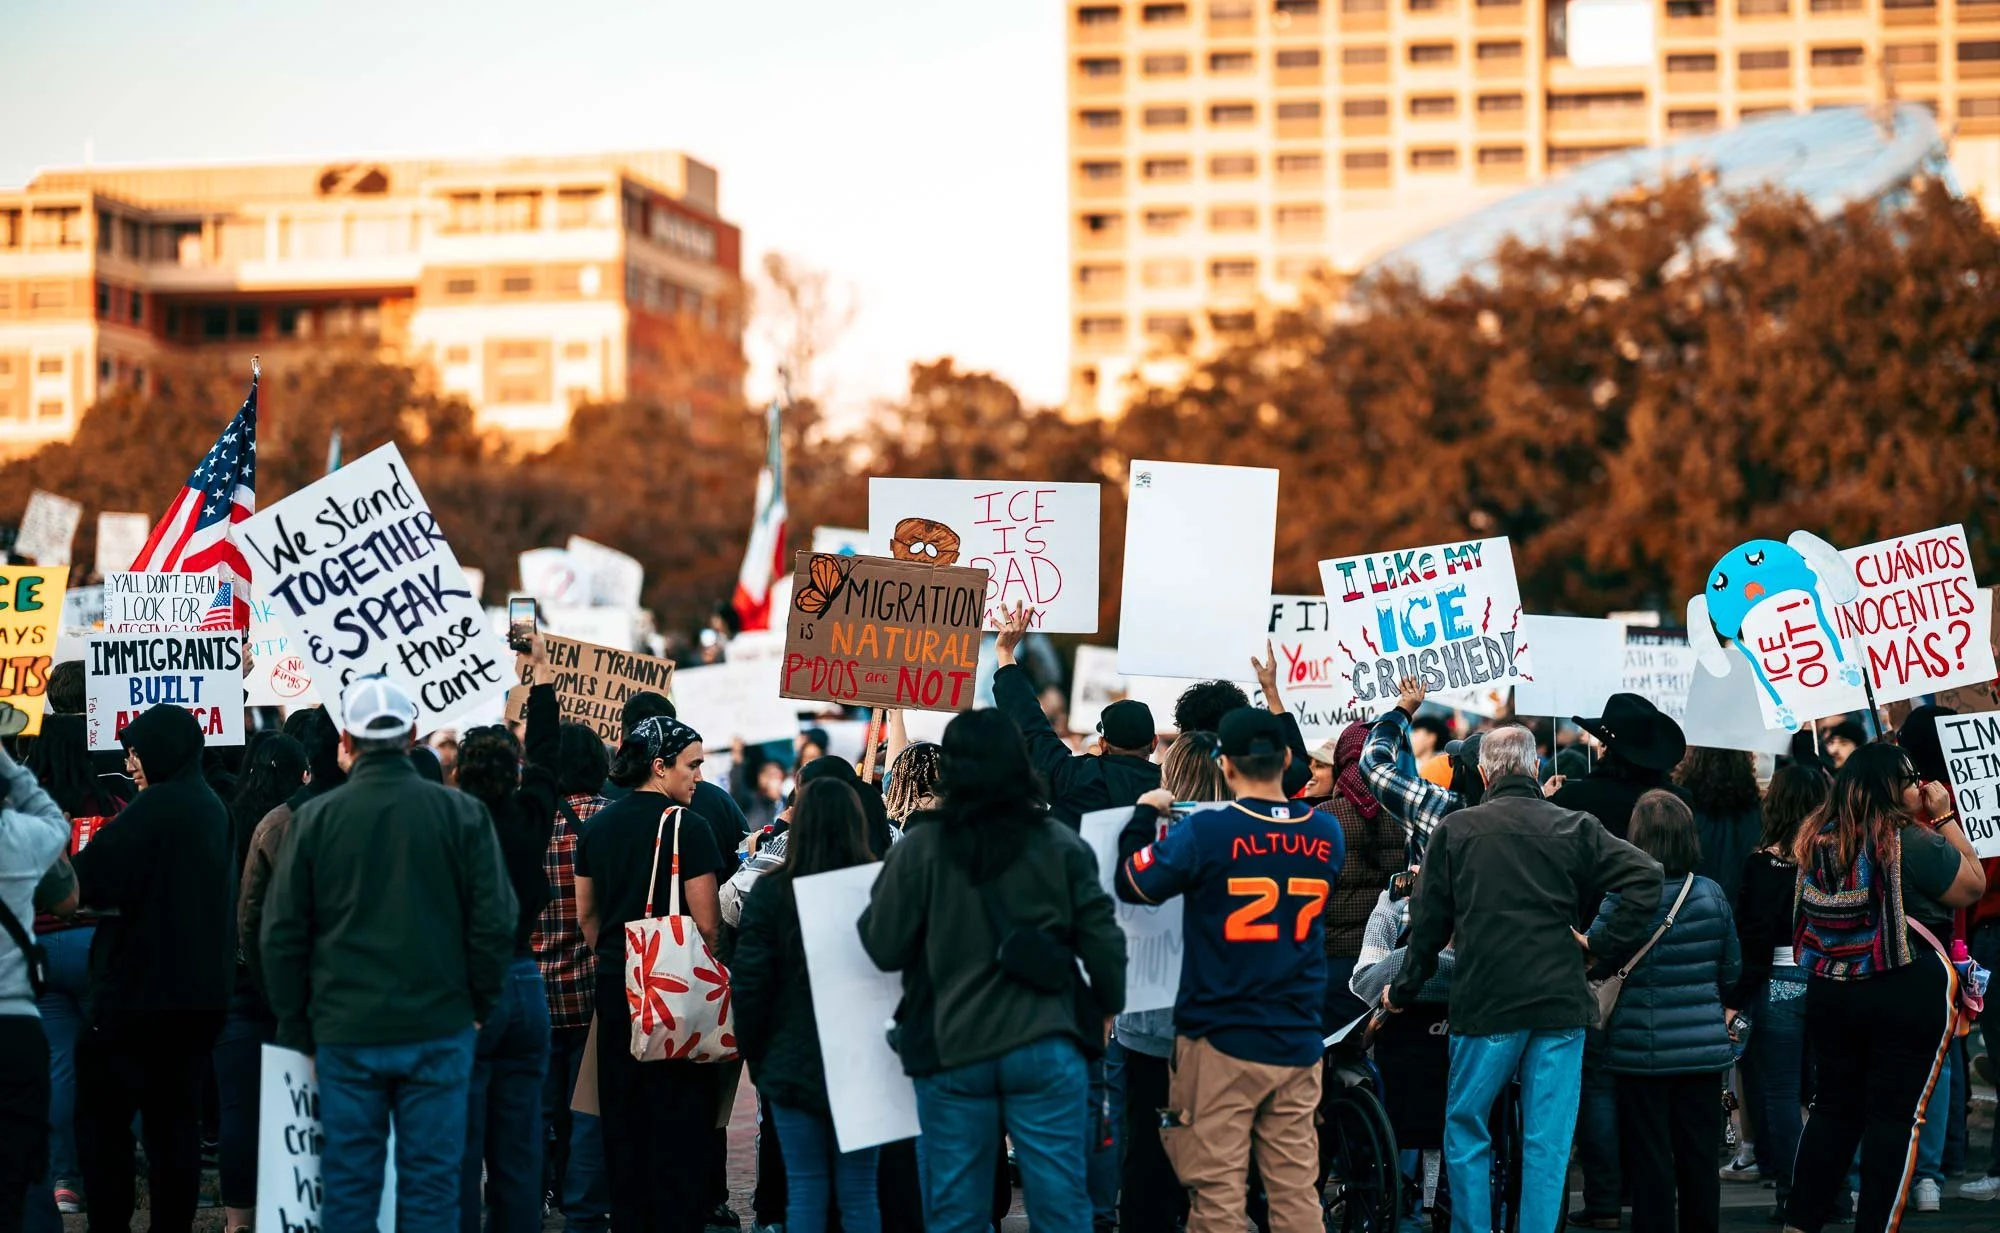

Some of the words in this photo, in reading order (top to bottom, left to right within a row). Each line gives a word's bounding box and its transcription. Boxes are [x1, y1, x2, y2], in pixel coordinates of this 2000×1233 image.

[974, 489, 1057, 524] ICE
[245, 514, 316, 575] We
[270, 511, 446, 617] TOGETHER
[992, 526, 1046, 555] IS
[1855, 536, 1965, 588] CUÁNTOS
[147, 575, 180, 594] DON'T
[185, 575, 215, 595] EVEN
[1336, 560, 1365, 603] I
[1443, 541, 1482, 576] MY
[123, 597, 165, 622] LOOK
[172, 598, 202, 624] FOR
[333, 565, 471, 660] SPEAK
[845, 578, 985, 628] MIGRATION
[1375, 582, 1473, 653] ICE
[1834, 576, 1976, 640] INOCENTES
[91, 636, 242, 676] IMMIGRANTS
[396, 615, 481, 677] those
[545, 639, 582, 669] HEN
[593, 649, 673, 690] TYRANNY
[831, 621, 980, 669] NATURAL
[1352, 630, 1518, 701] CRUSHED!
[1758, 631, 1793, 682] ICE
[129, 676, 204, 706] BUILT
[864, 671, 888, 684] are
[895, 665, 971, 706] NOT
[1959, 787, 1985, 812] OF
[1232, 832, 1332, 863] ALTUVE
[1224, 877, 1330, 943] 27
[1428, 1019, 1450, 1036] dr
